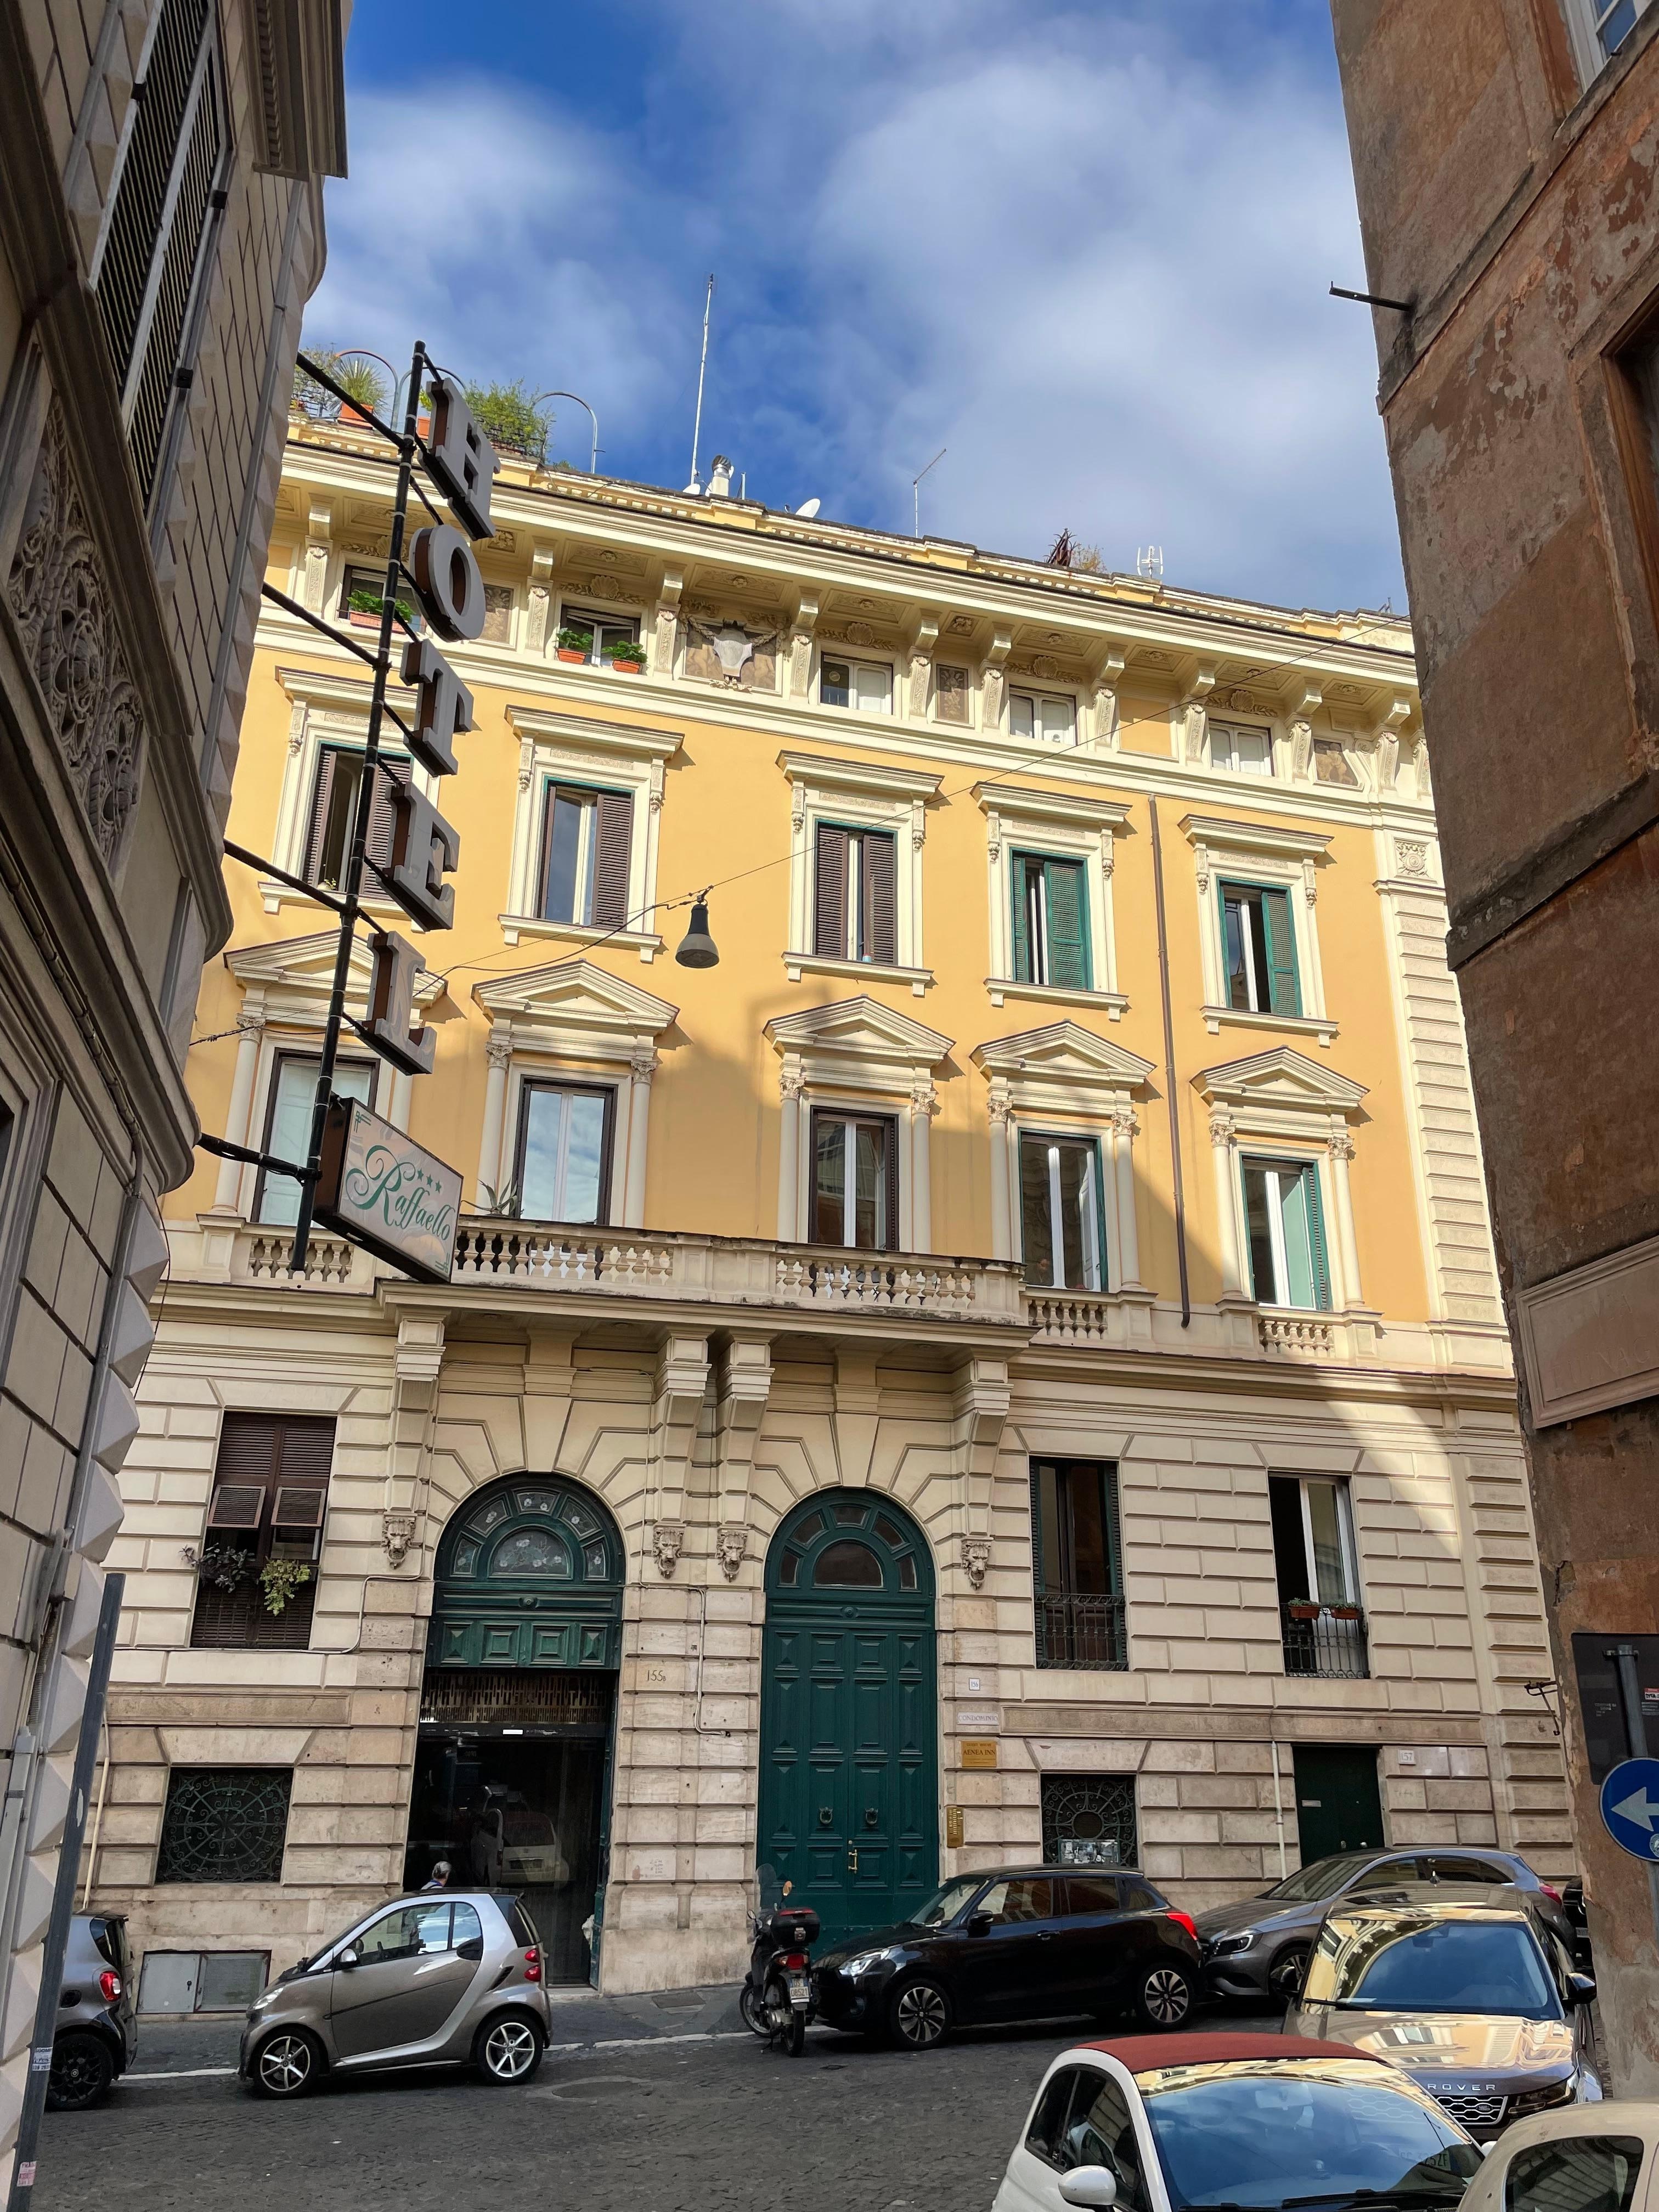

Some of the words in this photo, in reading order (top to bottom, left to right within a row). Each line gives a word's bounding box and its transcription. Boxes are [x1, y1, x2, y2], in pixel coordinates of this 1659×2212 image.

[359, 378, 500, 1076] HOTEL
[345, 1144, 456, 1241] Raffaello
[1401, 1752, 1413, 1761] 157
